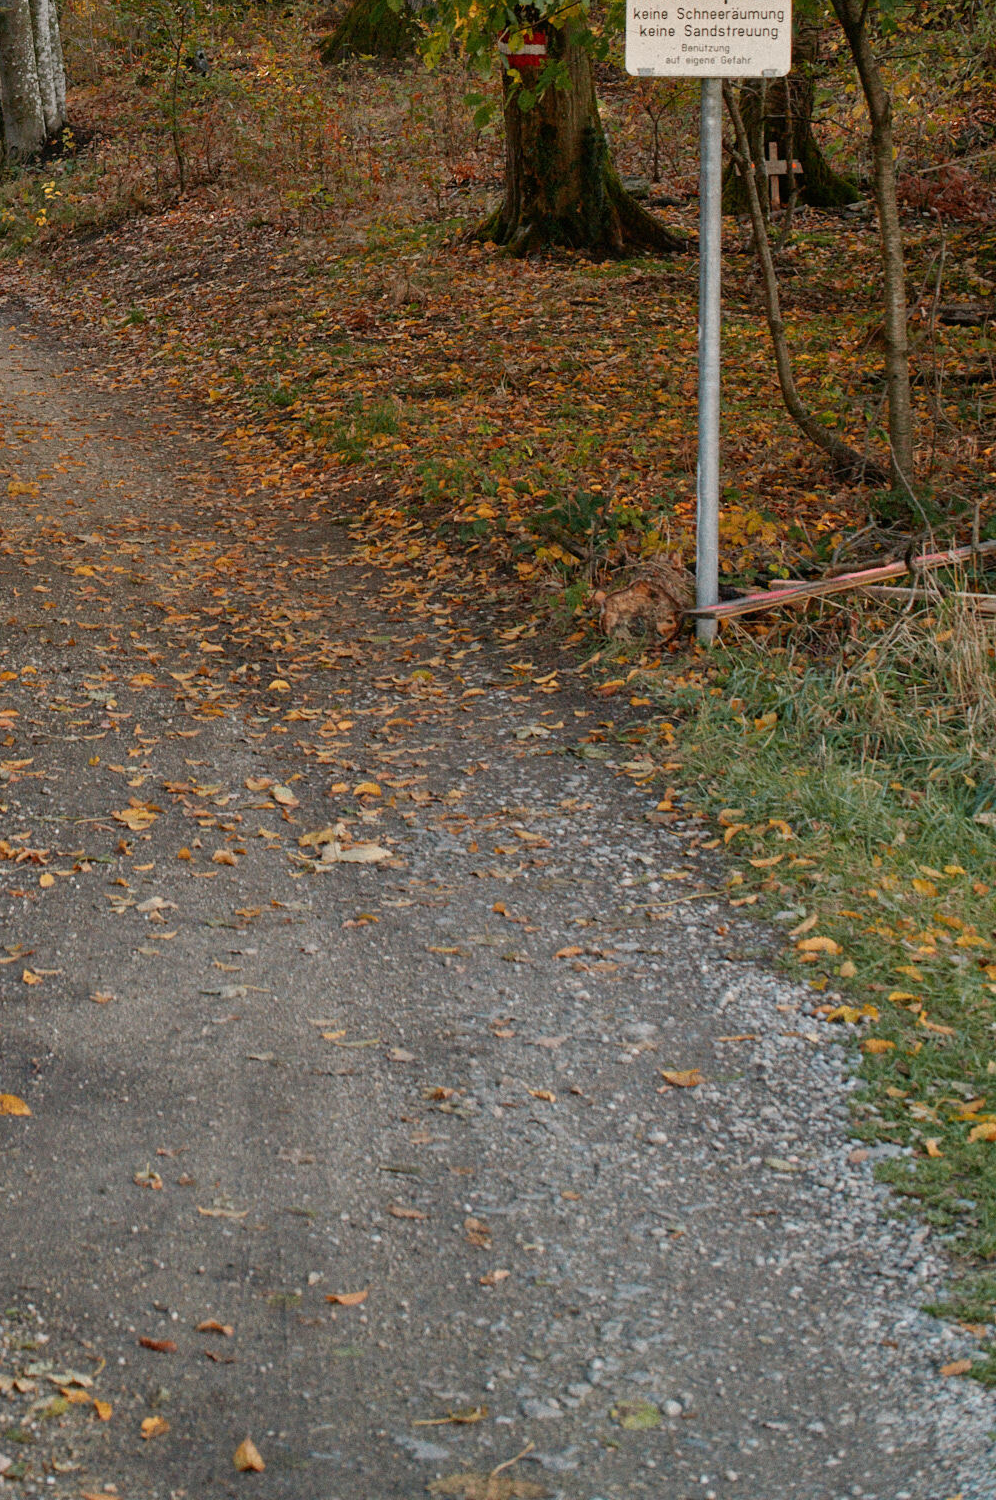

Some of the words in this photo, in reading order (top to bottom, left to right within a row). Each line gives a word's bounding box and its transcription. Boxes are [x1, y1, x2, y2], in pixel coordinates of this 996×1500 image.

[633, 8, 668, 20] keine
[677, 8, 785, 23] Schneeräumung
[639, 25, 675, 37] keine
[684, 25, 779, 40] Sandstreuung
[681, 43, 730, 54] Benützung
[665, 56, 680, 65] auf
[685, 56, 715, 67] eigene
[720, 56, 752, 65] Gefahr
